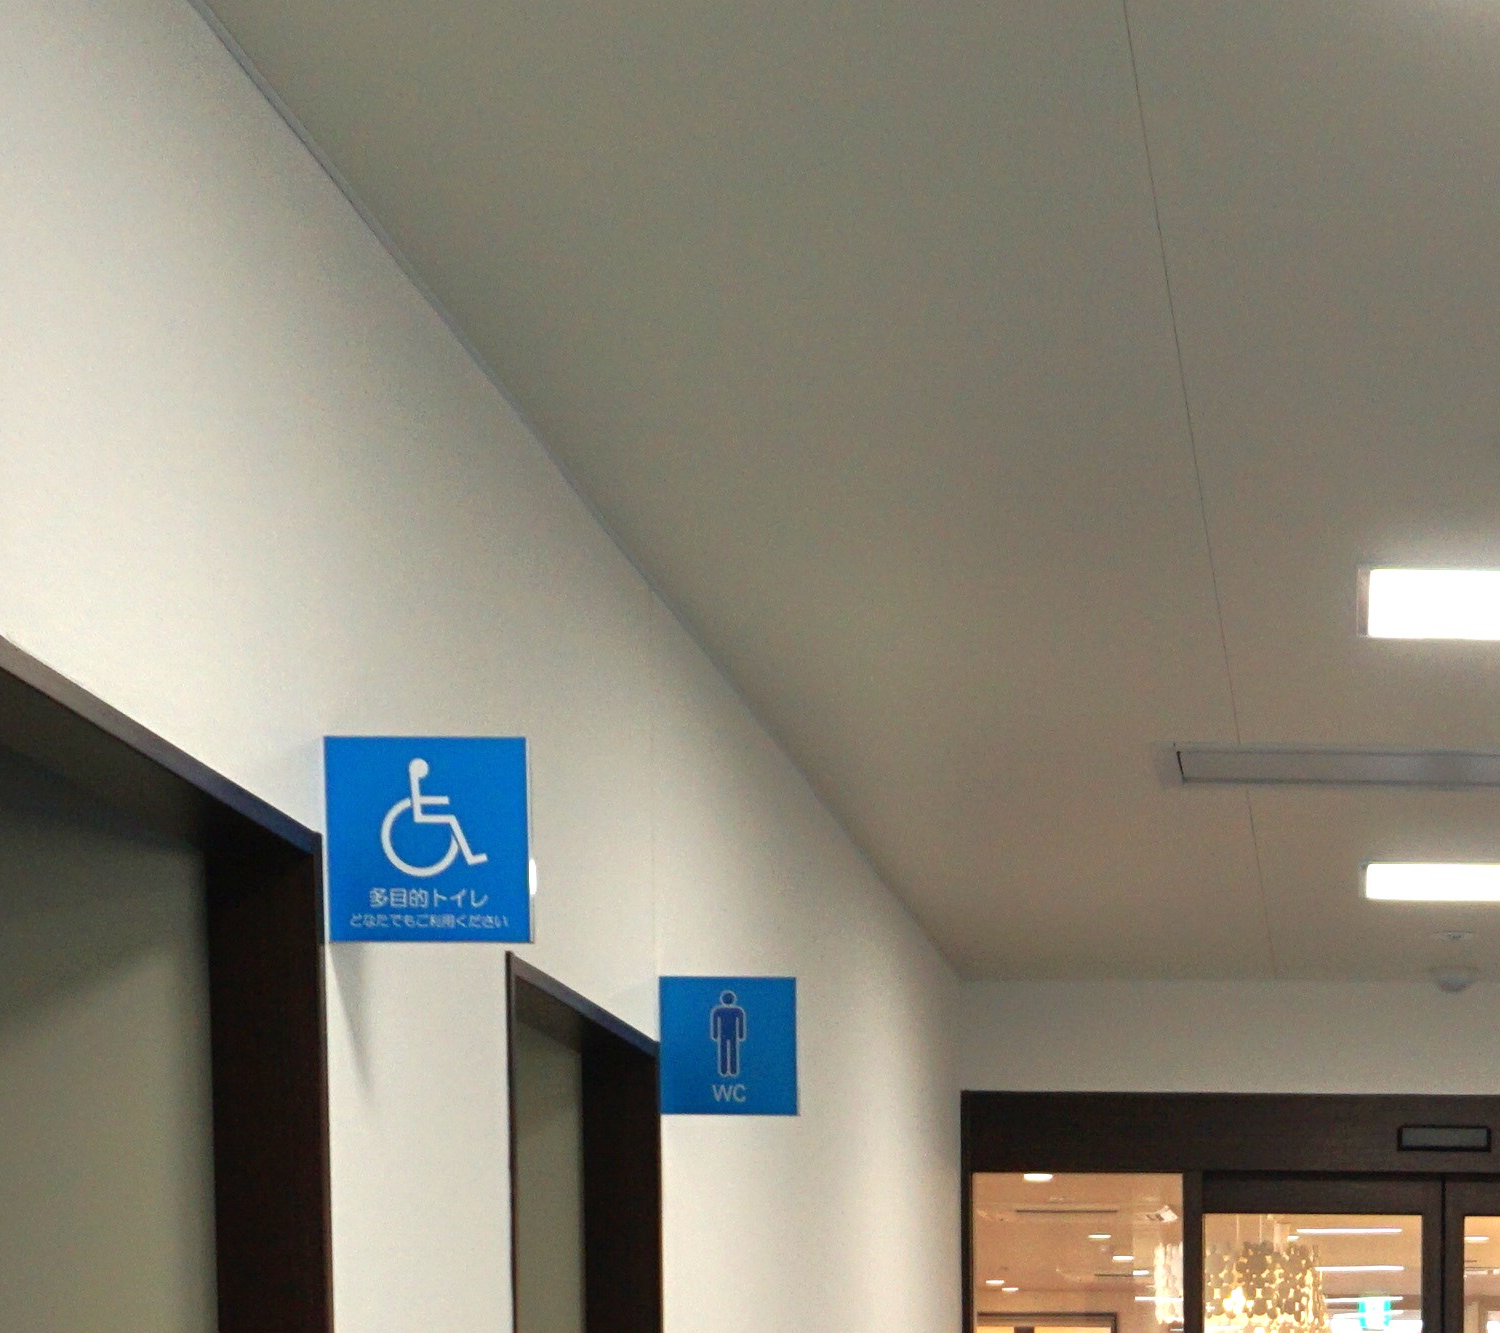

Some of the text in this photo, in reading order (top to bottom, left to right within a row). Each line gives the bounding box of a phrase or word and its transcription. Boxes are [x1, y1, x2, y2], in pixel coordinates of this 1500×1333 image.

[369, 888, 488, 908] 多目的トイレ
[350, 913, 509, 929] どなたでもご利用ください
[712, 1084, 747, 1103] WC
